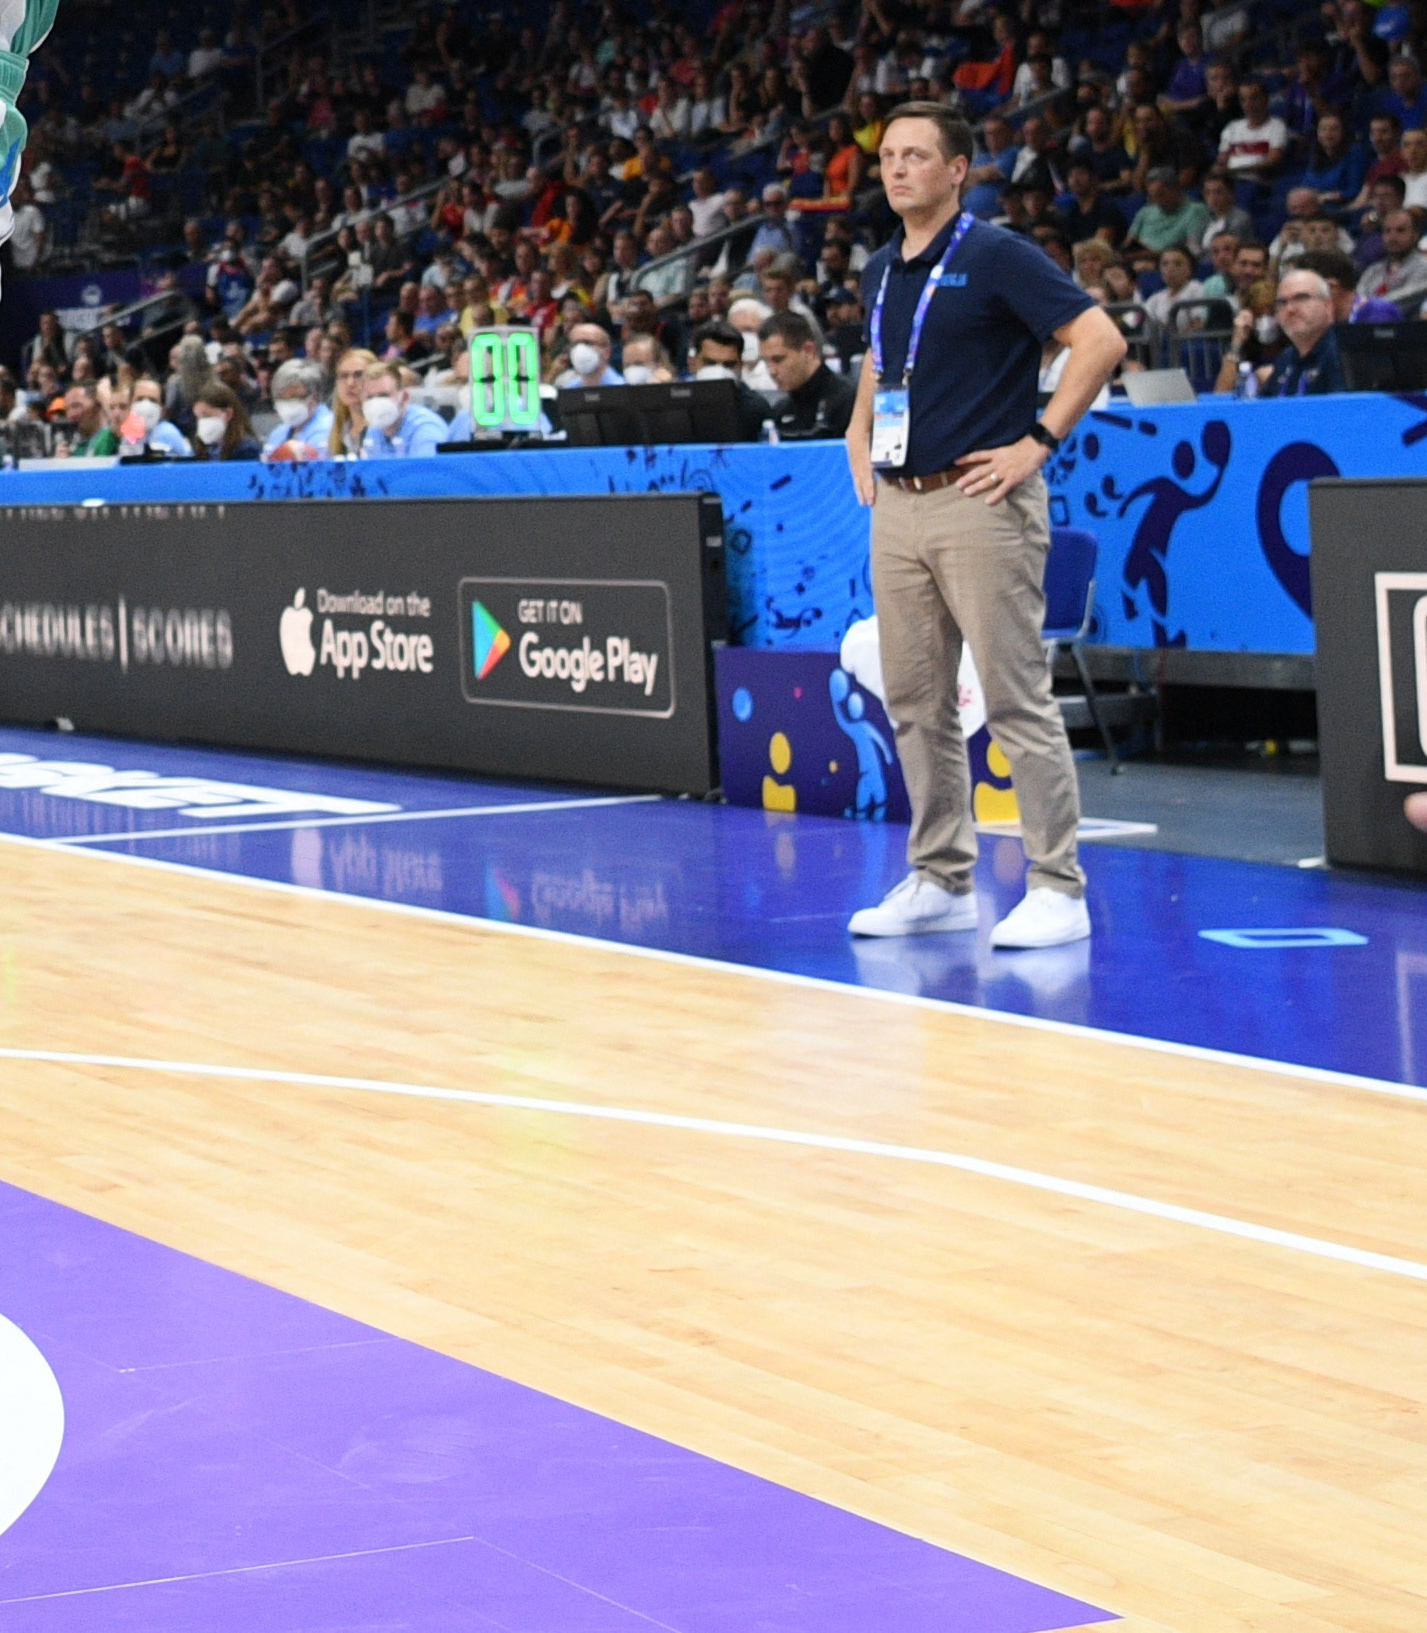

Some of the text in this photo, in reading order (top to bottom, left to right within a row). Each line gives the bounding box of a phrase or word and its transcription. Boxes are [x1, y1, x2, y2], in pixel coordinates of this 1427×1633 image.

[471, 332, 538, 427] 00
[316, 588, 431, 617] Download on the
[518, 599, 583, 625] GET IT ON
[132, 605, 234, 669] SCORES
[320, 618, 435, 679] App Store
[518, 631, 659, 697] Google Play
